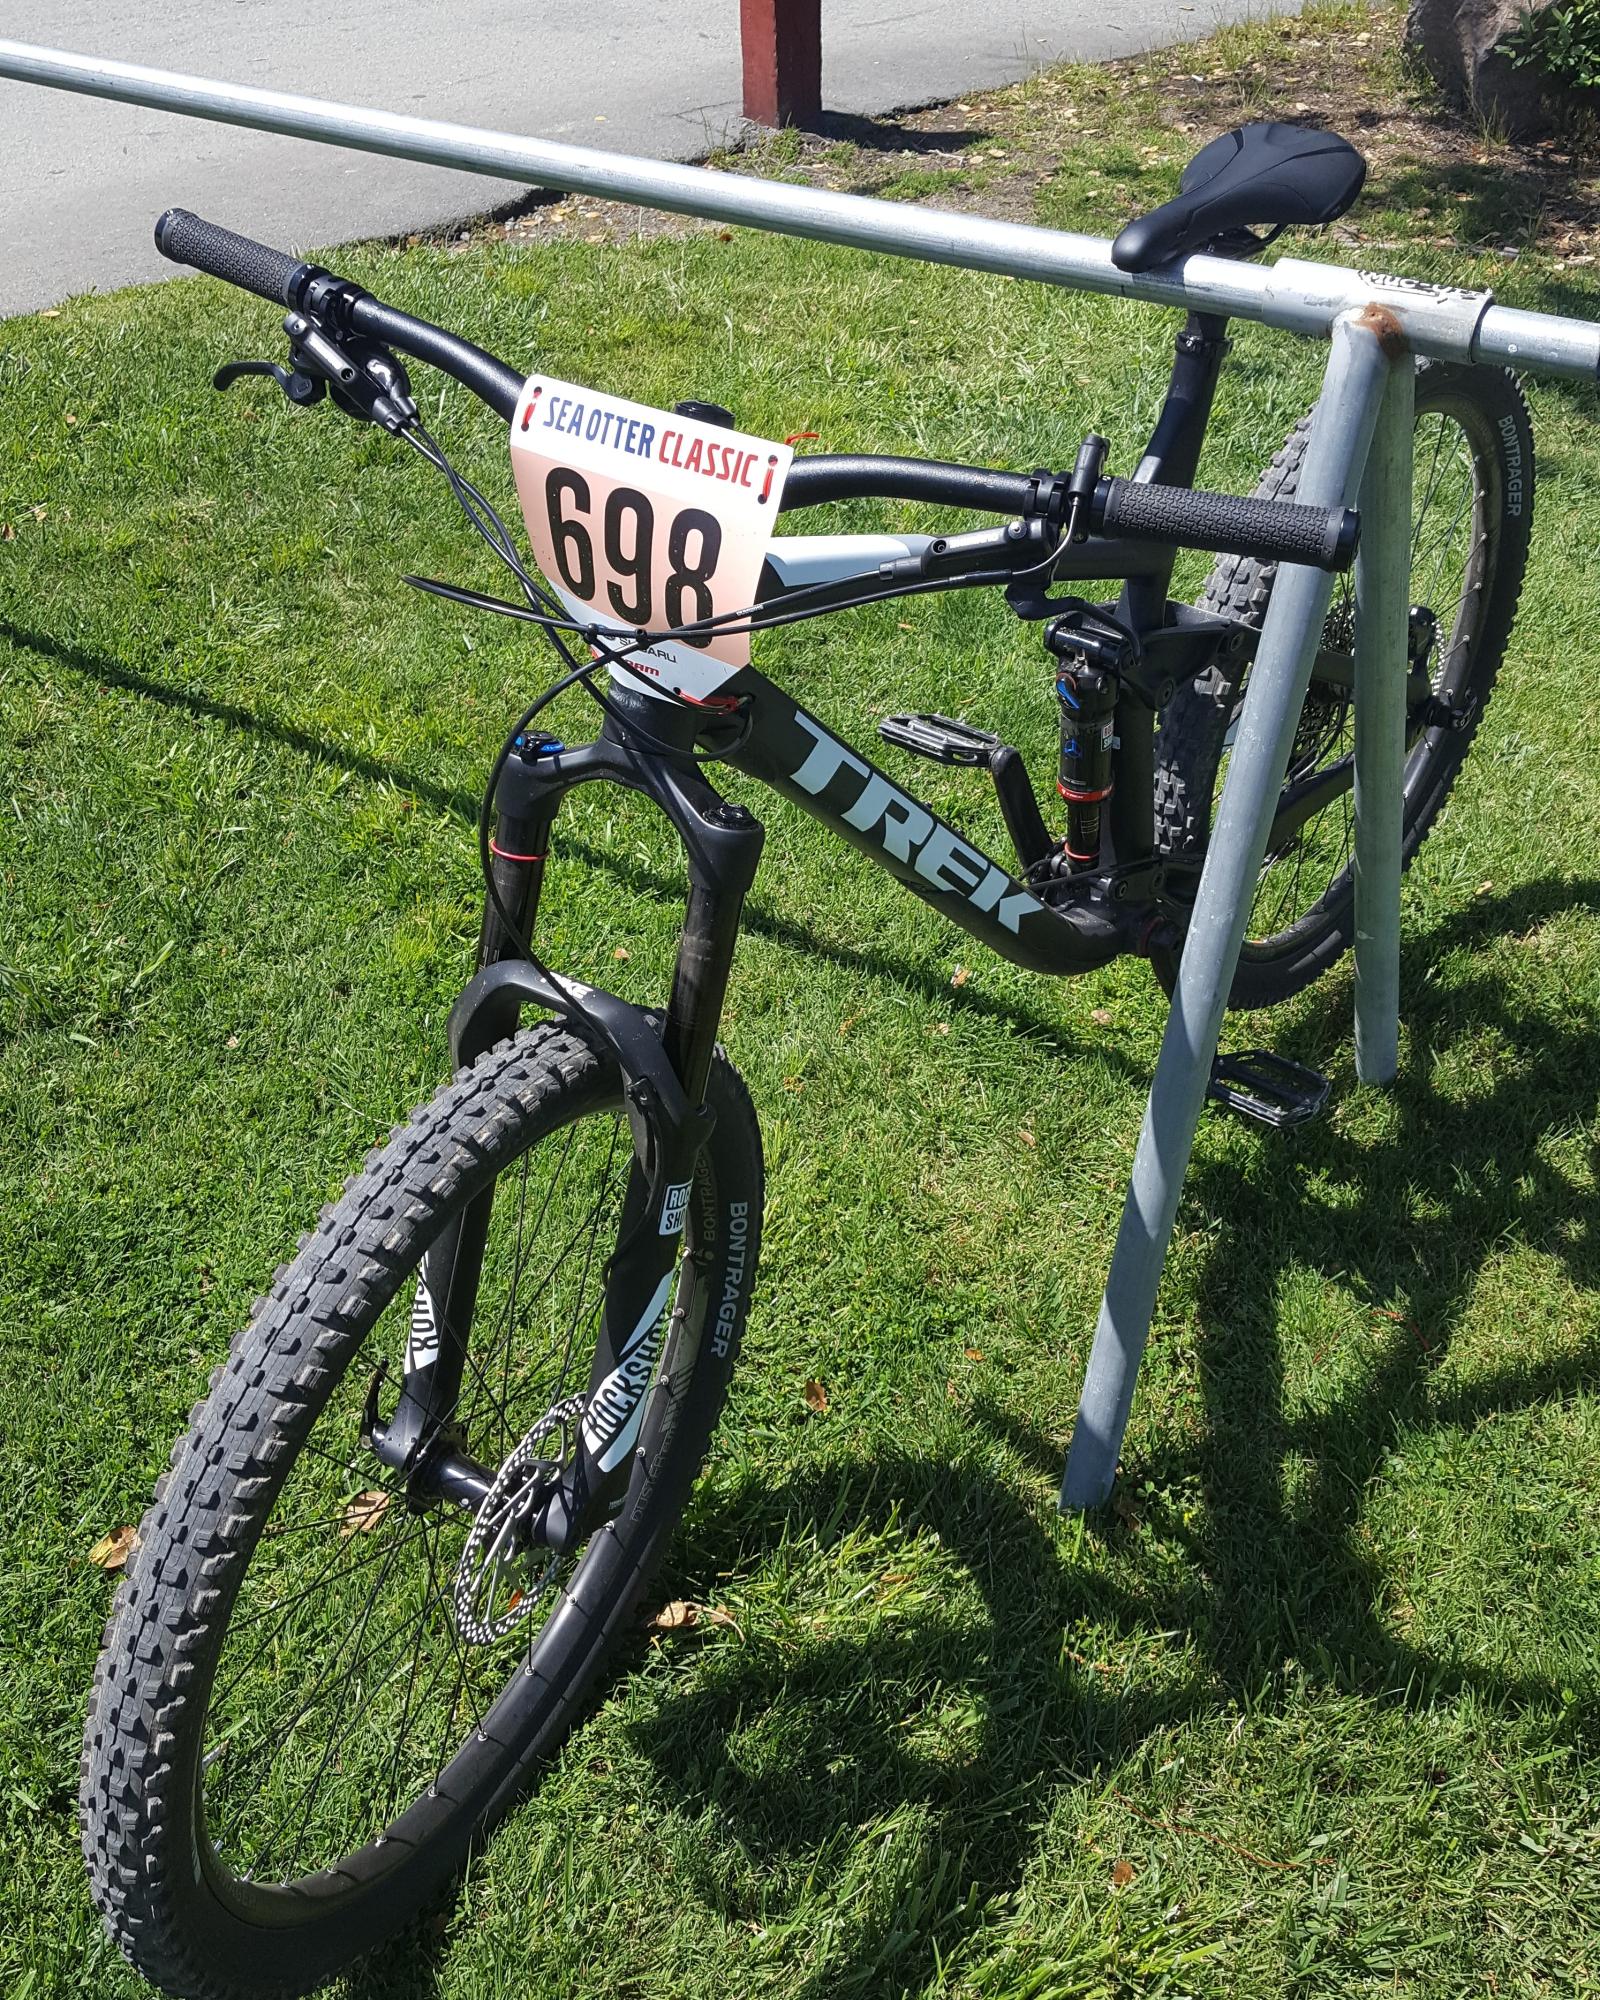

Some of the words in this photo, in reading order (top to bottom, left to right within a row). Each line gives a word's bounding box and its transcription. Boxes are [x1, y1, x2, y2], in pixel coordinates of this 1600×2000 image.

[543, 396, 582, 437] SEA
[585, 410, 655, 459] OTTER
[658, 430, 759, 488] CLASSIC
[1498, 414, 1523, 516] BONTRAGER
[545, 466, 722, 649] 698
[619, 637, 677, 664] SARU
[790, 710, 1044, 934] TREK
[710, 1202, 748, 1358] BONTRAGER
